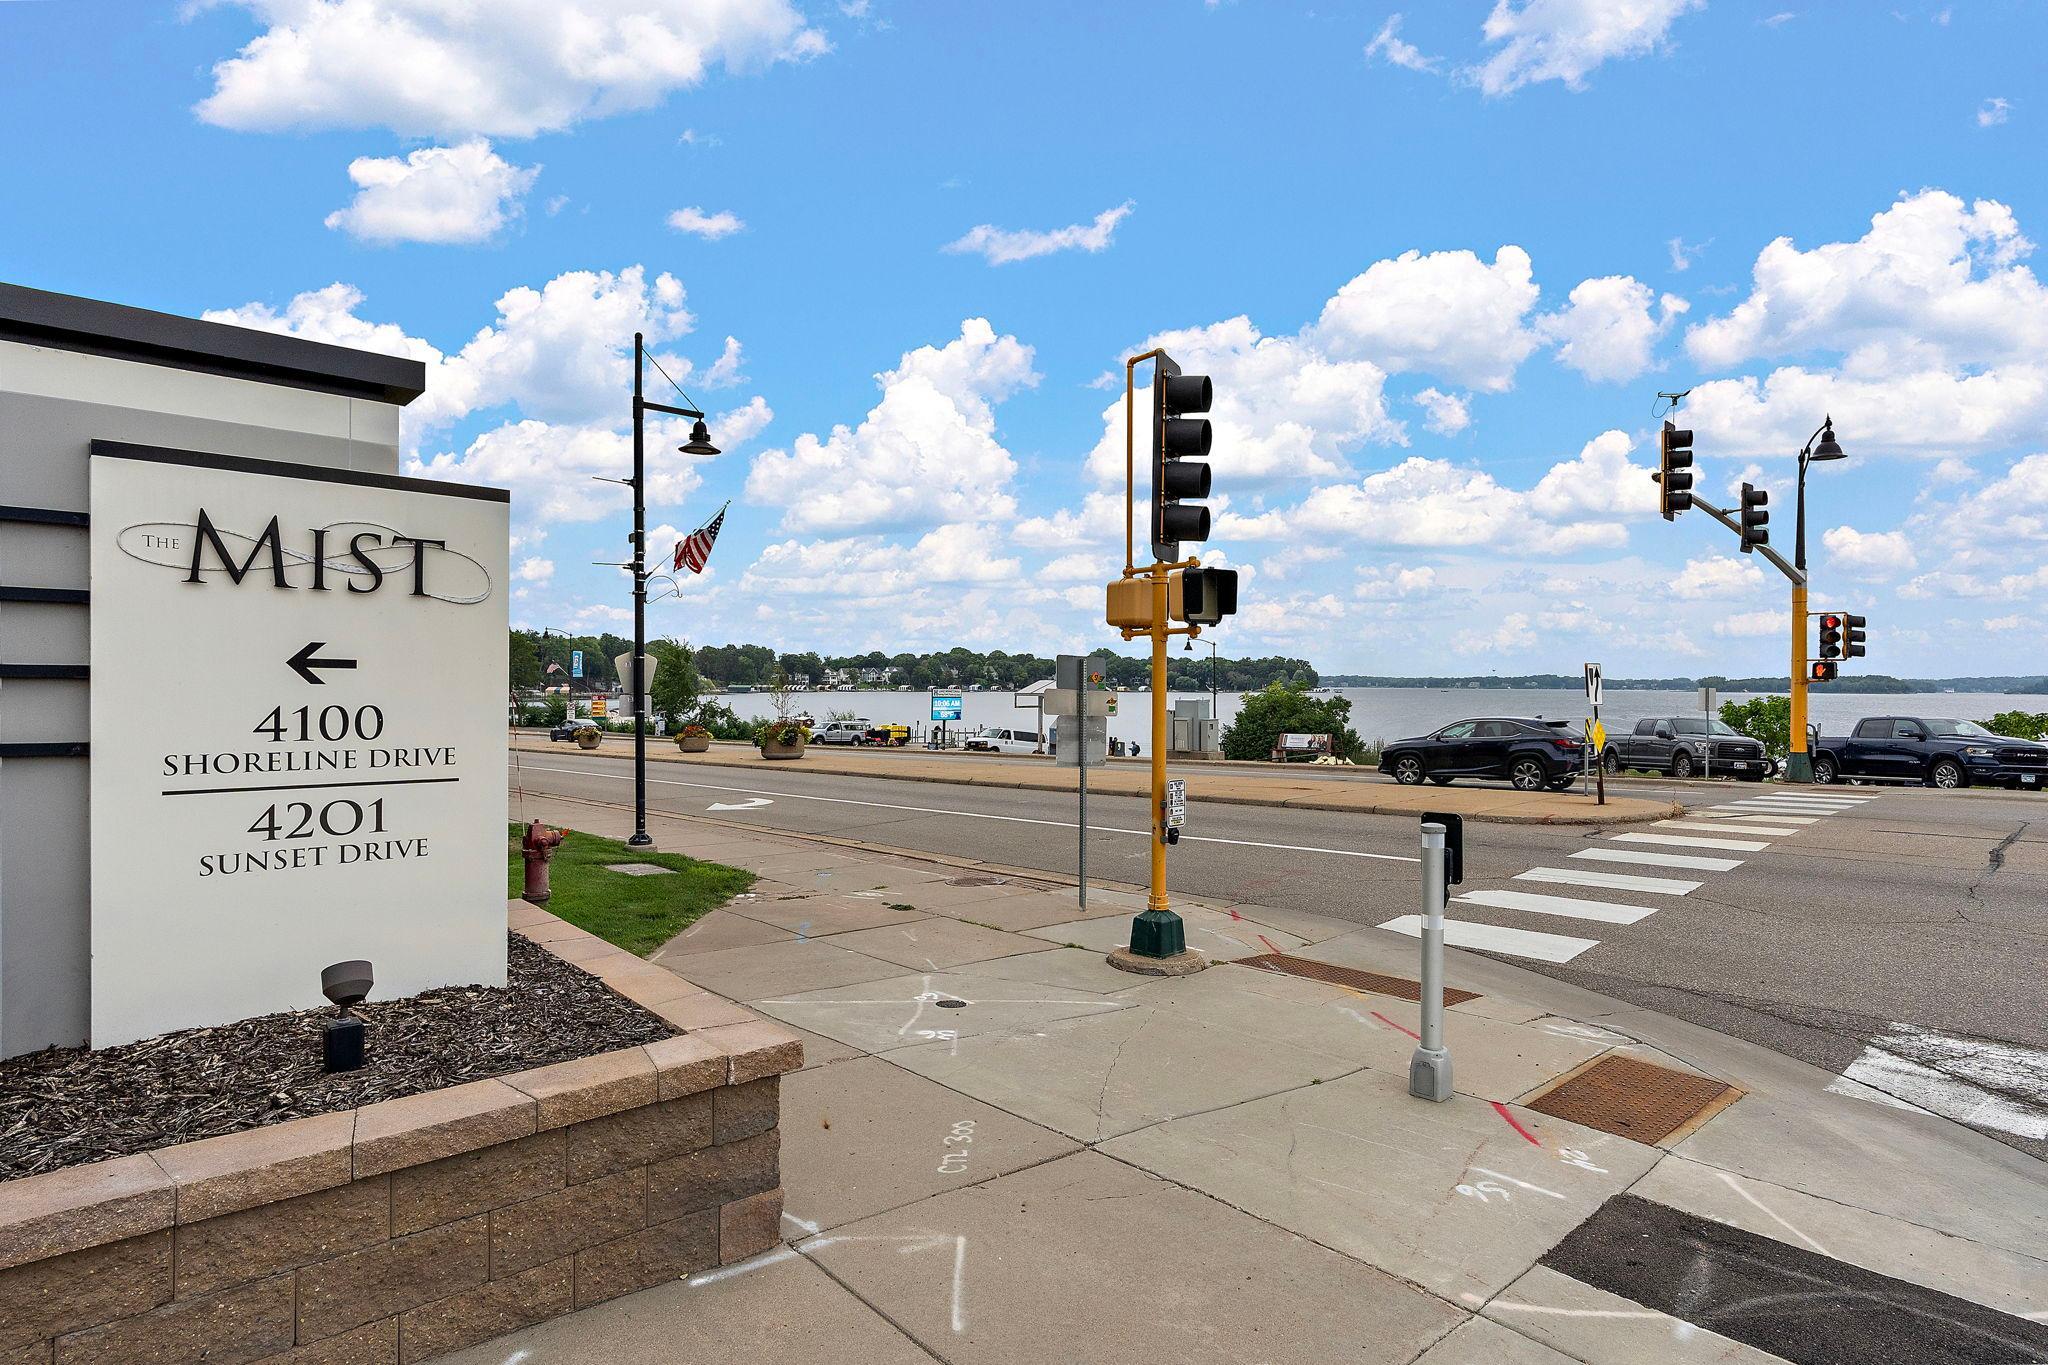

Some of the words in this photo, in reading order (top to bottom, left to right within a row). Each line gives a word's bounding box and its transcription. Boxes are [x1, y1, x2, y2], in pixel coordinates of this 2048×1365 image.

[181, 507, 446, 597] MIST
[252, 704, 384, 743] 4100
[163, 749, 357, 777] SHORELINE
[370, 747, 456, 768] DRIVE
[247, 797, 387, 842] 4201
[199, 846, 327, 877] SUNSET
[338, 837, 428, 865] DRIVE
